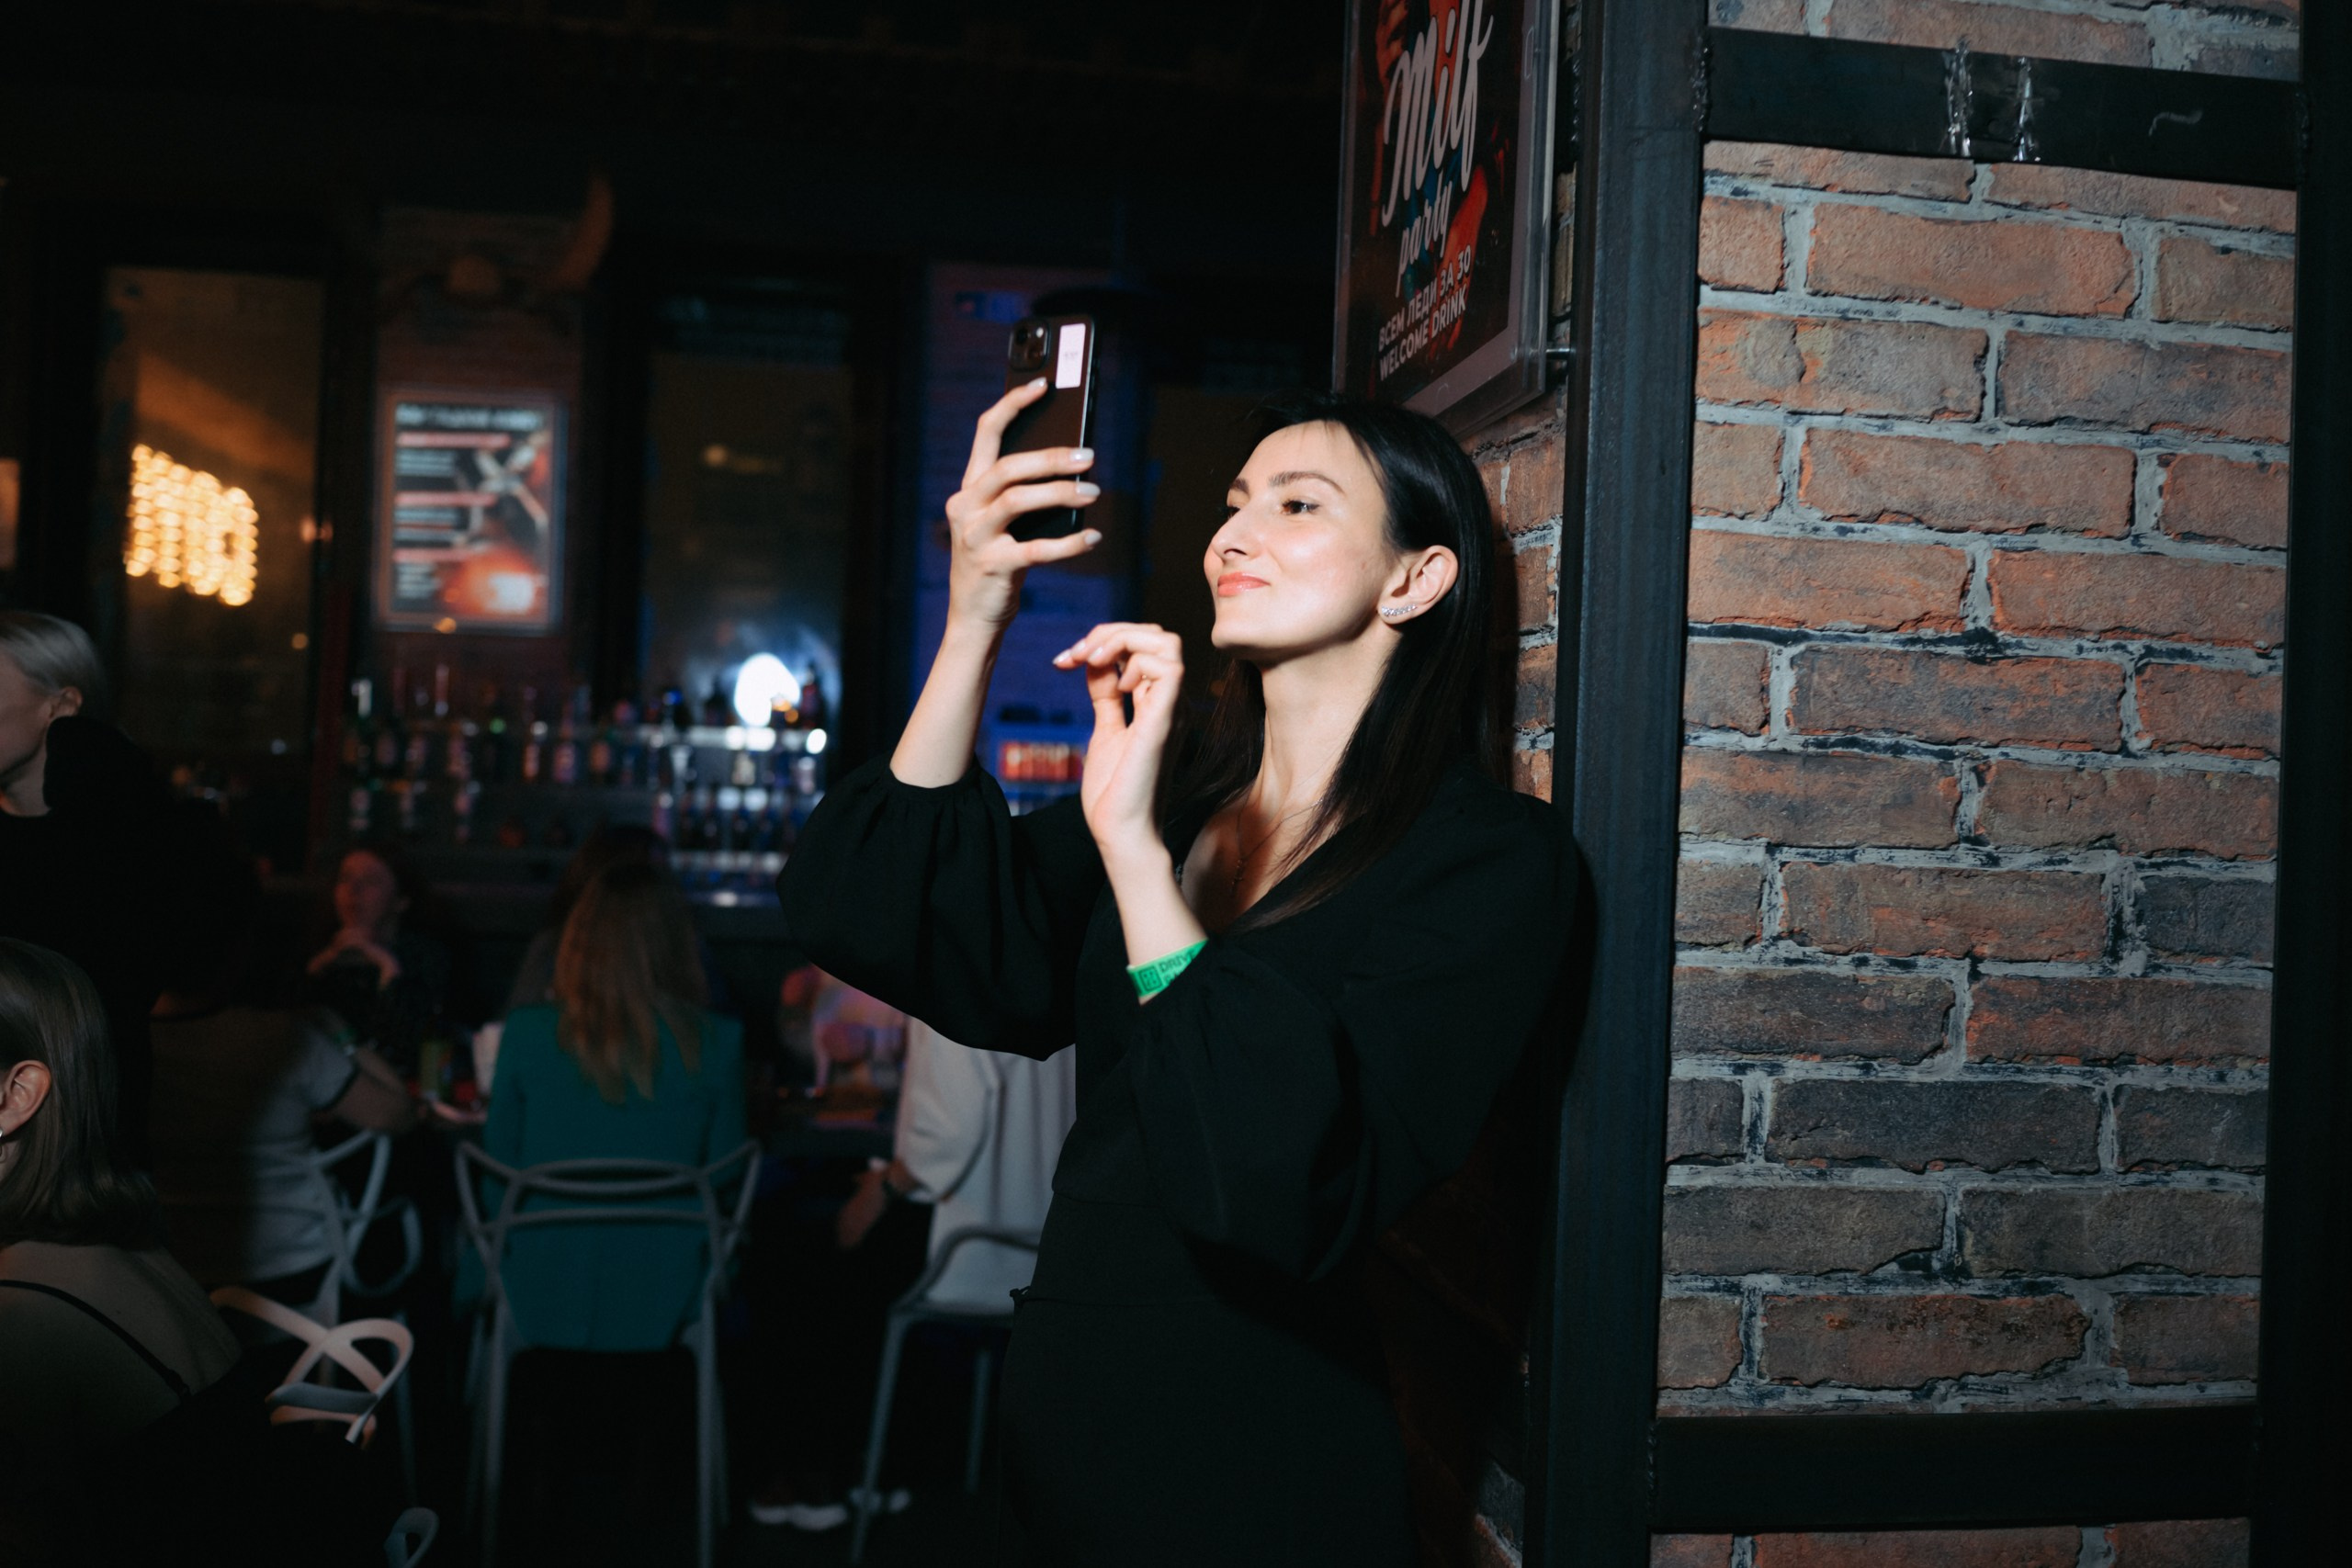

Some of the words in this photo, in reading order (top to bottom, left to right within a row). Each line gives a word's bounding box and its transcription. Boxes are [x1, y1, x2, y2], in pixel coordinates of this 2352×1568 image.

[1381, 0, 1494, 227] Milf
[1395, 167, 1453, 298] party
[1378, 308, 1405, 351] ВСЕМ
[1407, 277, 1437, 326] ЛЕДИ
[1439, 263, 1454, 297] ЗА
[1456, 244, 1471, 281] 30
[1379, 322, 1430, 381] WELCOME
[1431, 285, 1467, 338] DRINK
